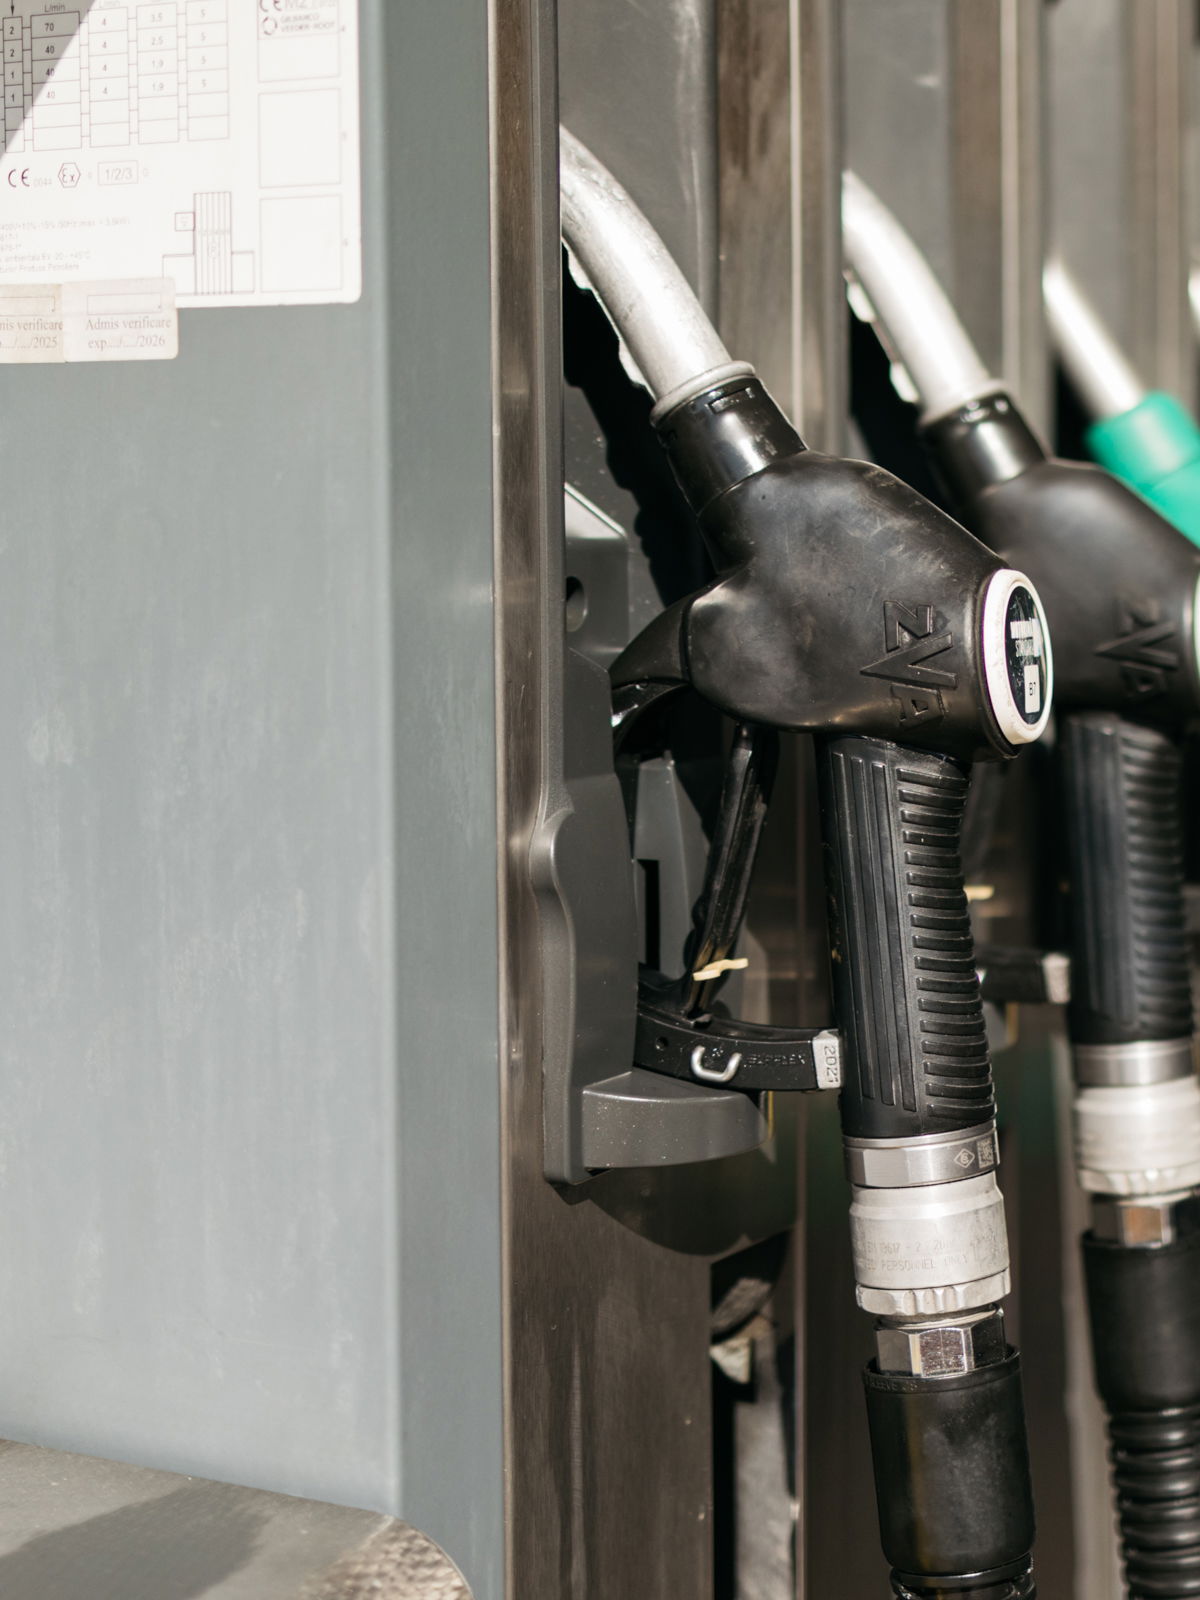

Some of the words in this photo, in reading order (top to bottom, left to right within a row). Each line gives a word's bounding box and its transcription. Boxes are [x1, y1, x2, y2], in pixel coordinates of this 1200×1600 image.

[44, 3, 66, 12] L/min
[9, 26, 14, 35] 2
[44, 23, 54, 32] 70
[101, 18, 107, 26] 4
[9, 49, 14, 57] 2
[45, 45, 55, 54] 40
[101, 41, 107, 49] 4
[11, 71, 15, 79] 1
[45, 68, 55, 76] 40
[102, 64, 108, 72] 4
[11, 93, 15, 102] 1
[46, 91, 55, 99] 40
[102, 86, 108, 95] 4
[7, 168, 30, 188] CE
[105, 167, 133, 181] 1/2/3
[17, 318, 64, 331] verificare
[86, 317, 120, 331] Admis
[122, 315, 172, 329] verificare
[824, 1045, 839, 1084] 2021
[881, 1256, 937, 1272] PERSONNEL
